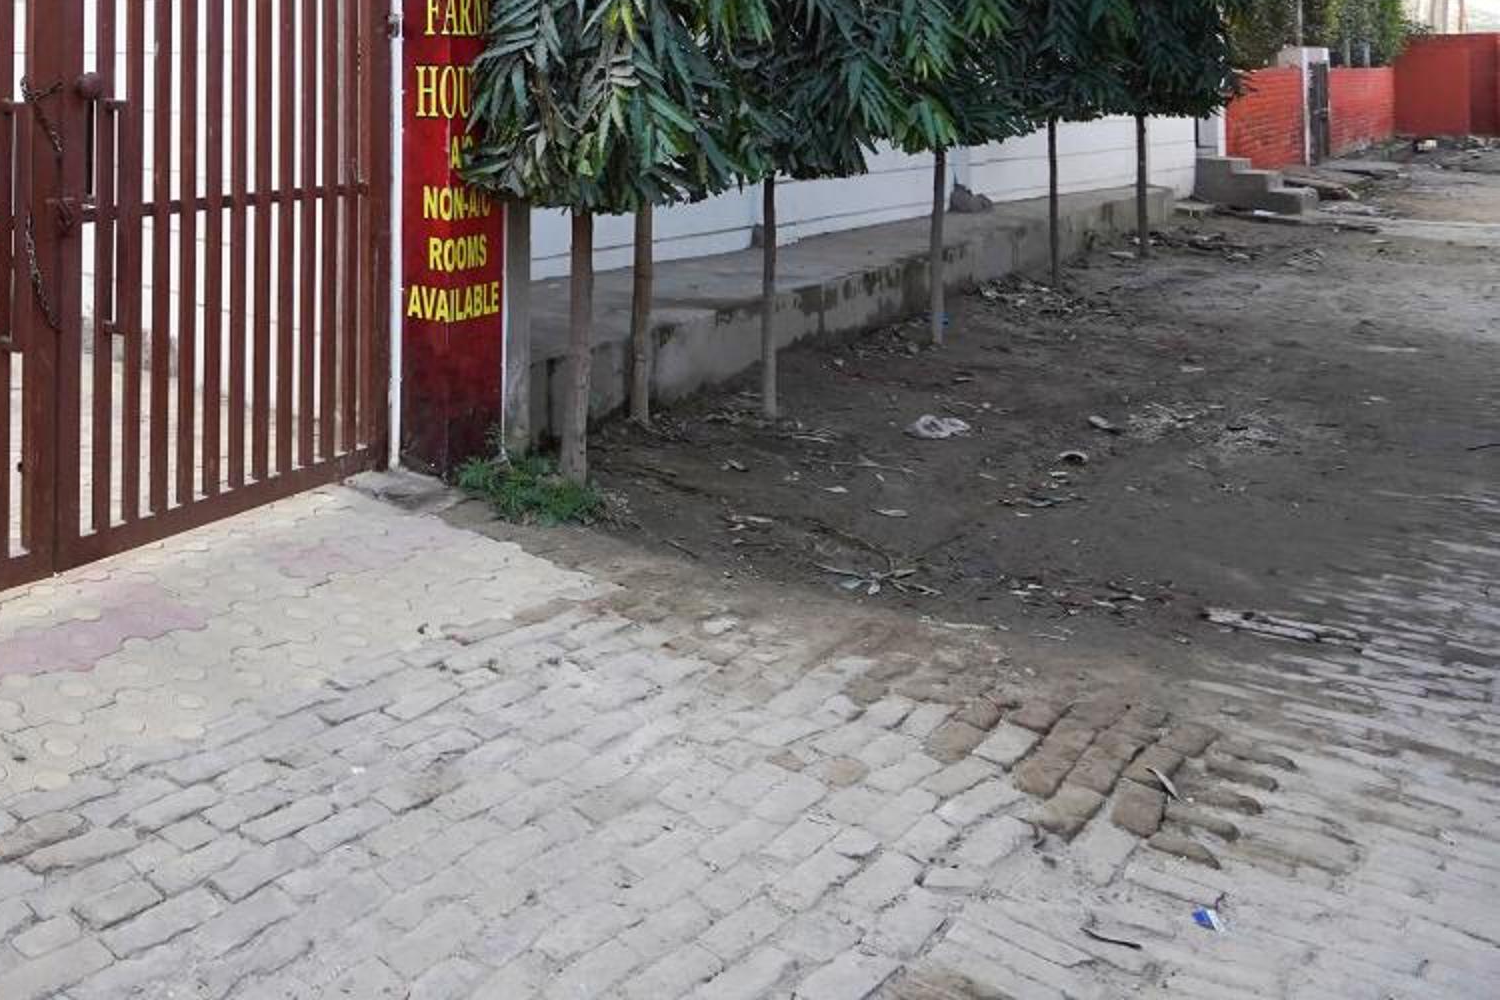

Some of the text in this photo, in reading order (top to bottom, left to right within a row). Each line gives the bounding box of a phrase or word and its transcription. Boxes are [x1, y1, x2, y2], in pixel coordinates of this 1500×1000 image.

[415, 65, 473, 119] HOU
[422, 184, 491, 221] NON-A/C
[428, 233, 487, 272] ROOMS
[406, 281, 499, 323] AVAILABLE
